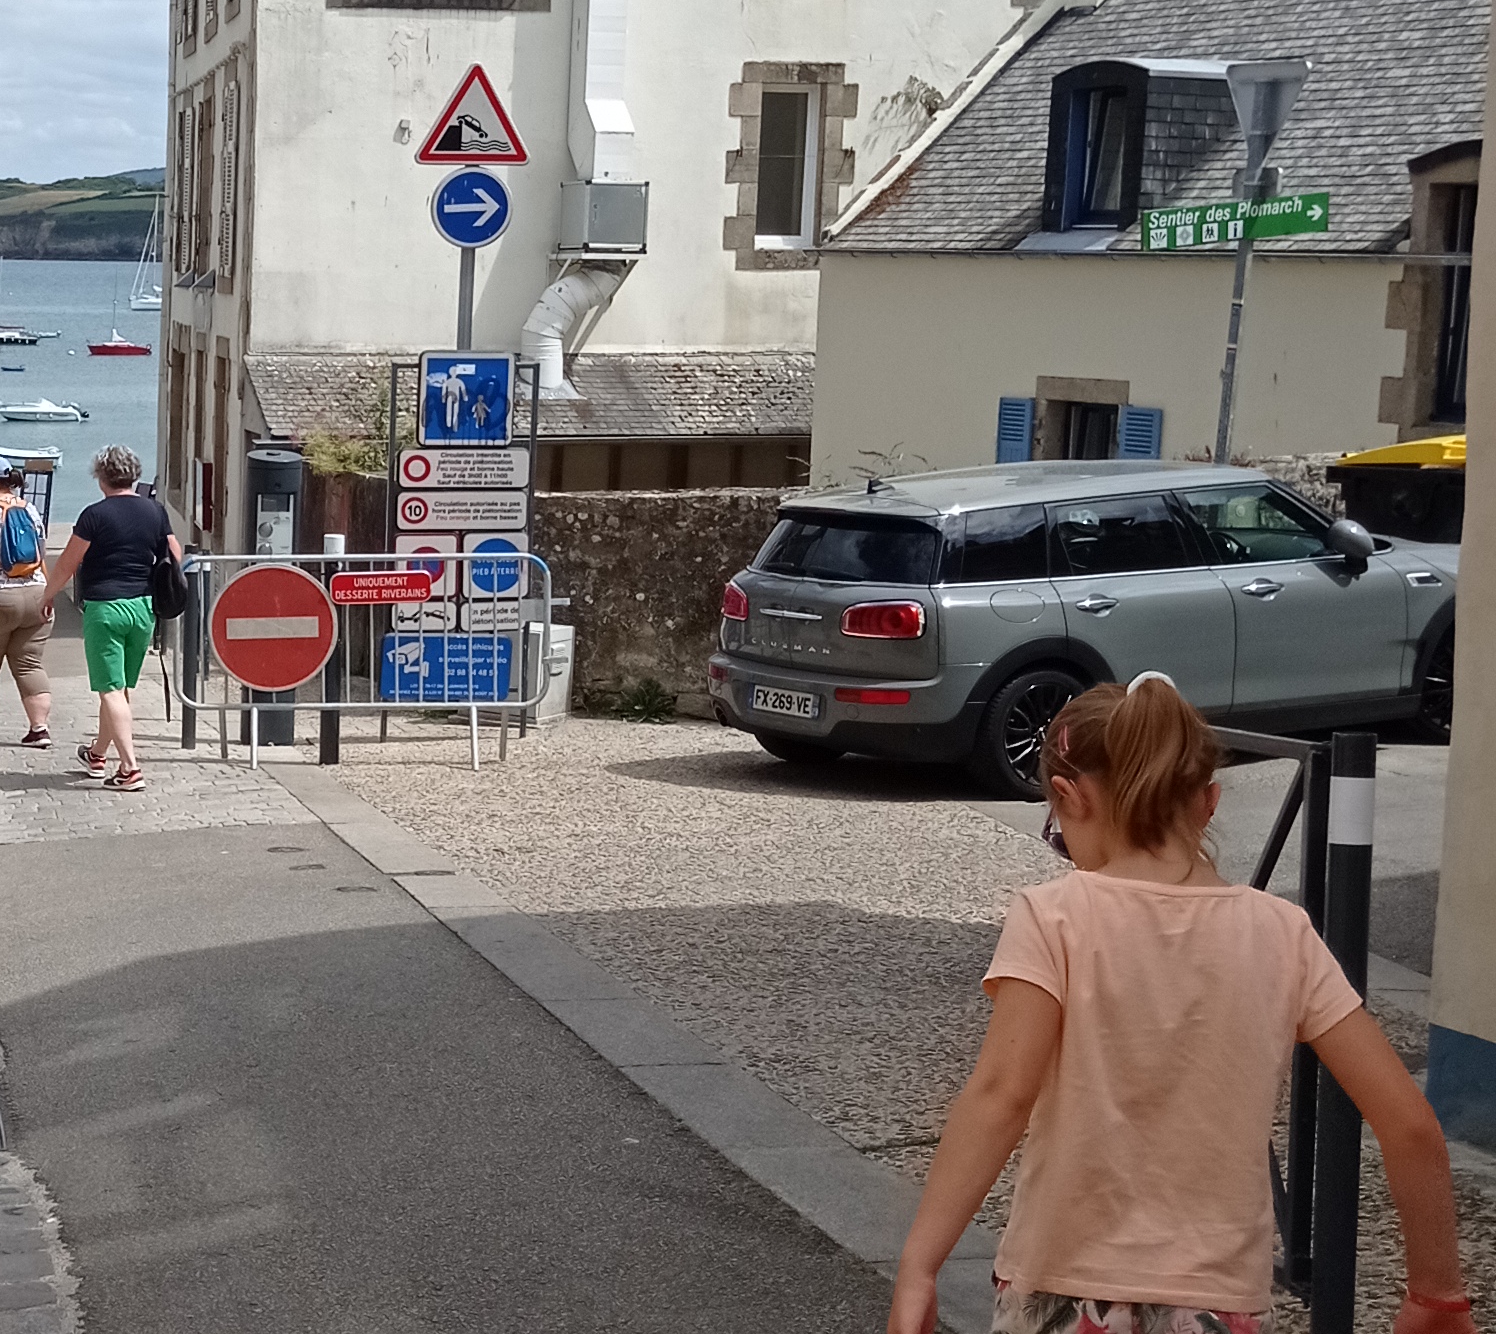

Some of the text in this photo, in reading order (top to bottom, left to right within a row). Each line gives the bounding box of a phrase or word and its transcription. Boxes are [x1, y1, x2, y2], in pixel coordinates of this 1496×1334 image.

[1148, 209, 1200, 228] Sentier
[1206, 205, 1231, 222] des
[438, 459, 462, 467] période
[407, 505, 422, 517] 10
[472, 567, 490, 575] PIED
[353, 576, 408, 587] UNIQUEMENT
[335, 588, 427, 600] DESSERTE RIVERAINS
[755, 688, 812, 715] FX-269-VE
